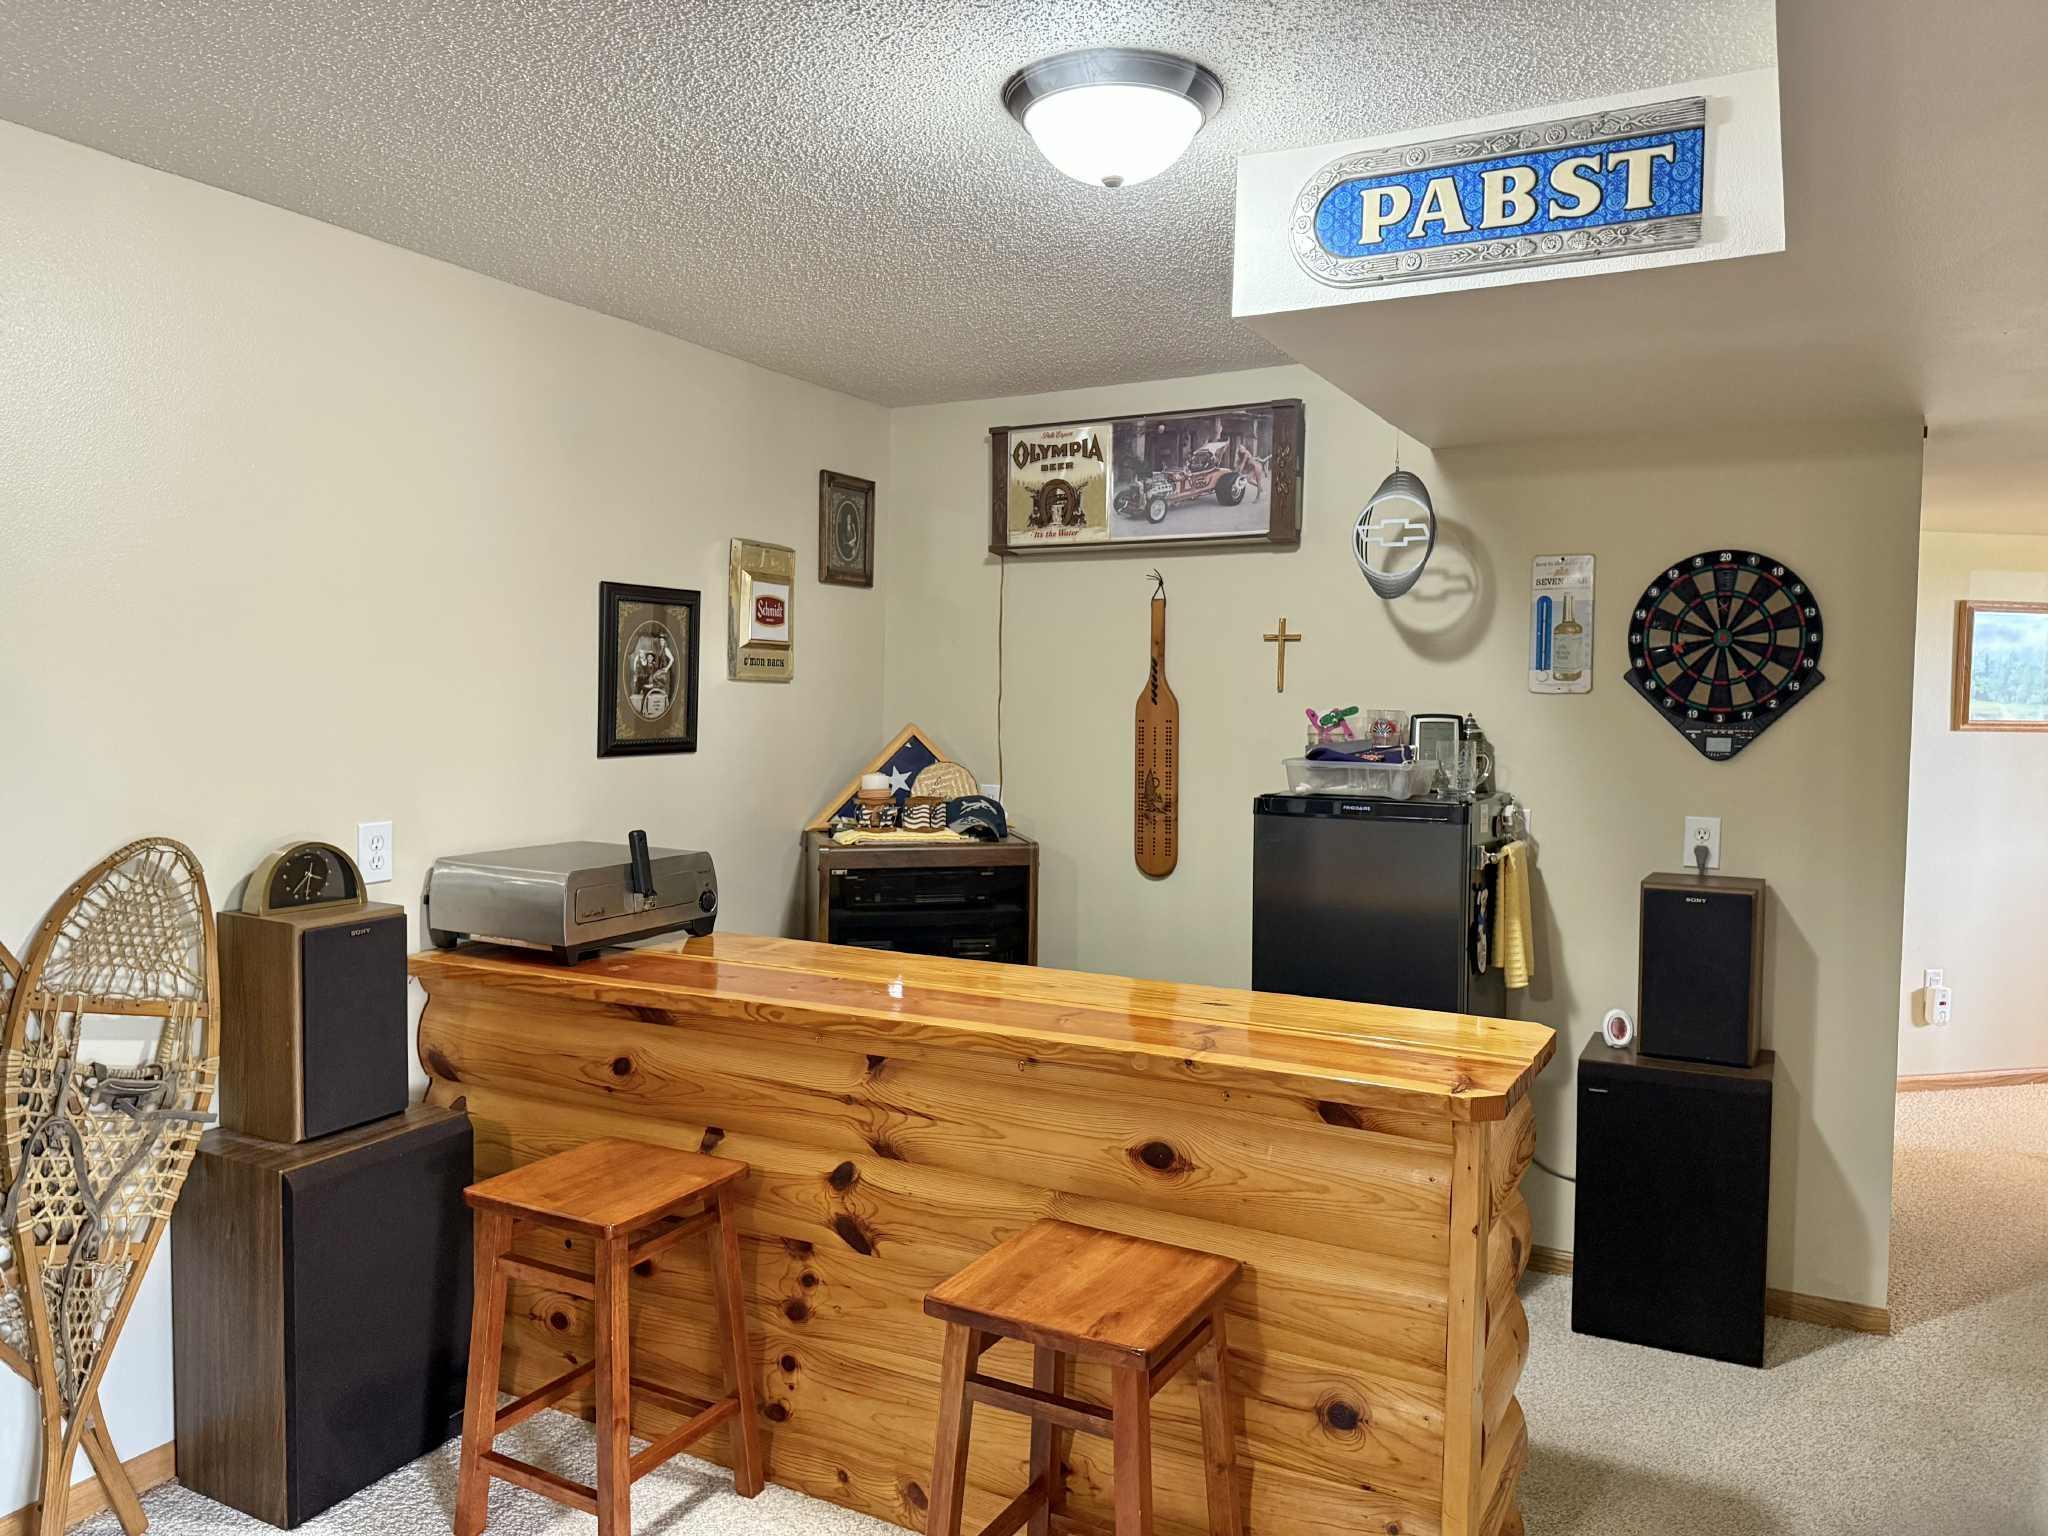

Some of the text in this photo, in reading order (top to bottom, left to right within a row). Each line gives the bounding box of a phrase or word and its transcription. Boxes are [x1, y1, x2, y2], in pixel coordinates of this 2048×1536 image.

[1358, 143, 1676, 245] PABST
[1013, 433, 1104, 470] OLYMPIA
[1041, 461, 1074, 472] BEER
[1720, 553, 1732, 561] 20
[1750, 557, 1756, 565] 1
[1695, 558, 1702, 566] 5
[1667, 570, 1679, 578] 12
[1772, 567, 1784, 576] 18
[1536, 577, 1563, 586] SEVEN
[1651, 588, 1657, 596] 9
[1794, 585, 1801, 593] 4
[757, 599, 784, 618] Schmidt
[1805, 608, 1816, 616] 13
[1635, 610, 1646, 618] 14
[1632, 635, 1641, 643] 11
[1811, 634, 1817, 642] 6
[1636, 659, 1643, 667] 8
[1803, 659, 1814, 667] 10
[1645, 681, 1656, 689] 16
[1788, 682, 1800, 690] 15
[1666, 699, 1672, 707] 7
[1770, 700, 1776, 708] 2
[1687, 710, 1698, 718] 19
[1716, 714, 1723, 722] 3
[1742, 711, 1753, 719] 17
[351, 927, 371, 936] SONY
